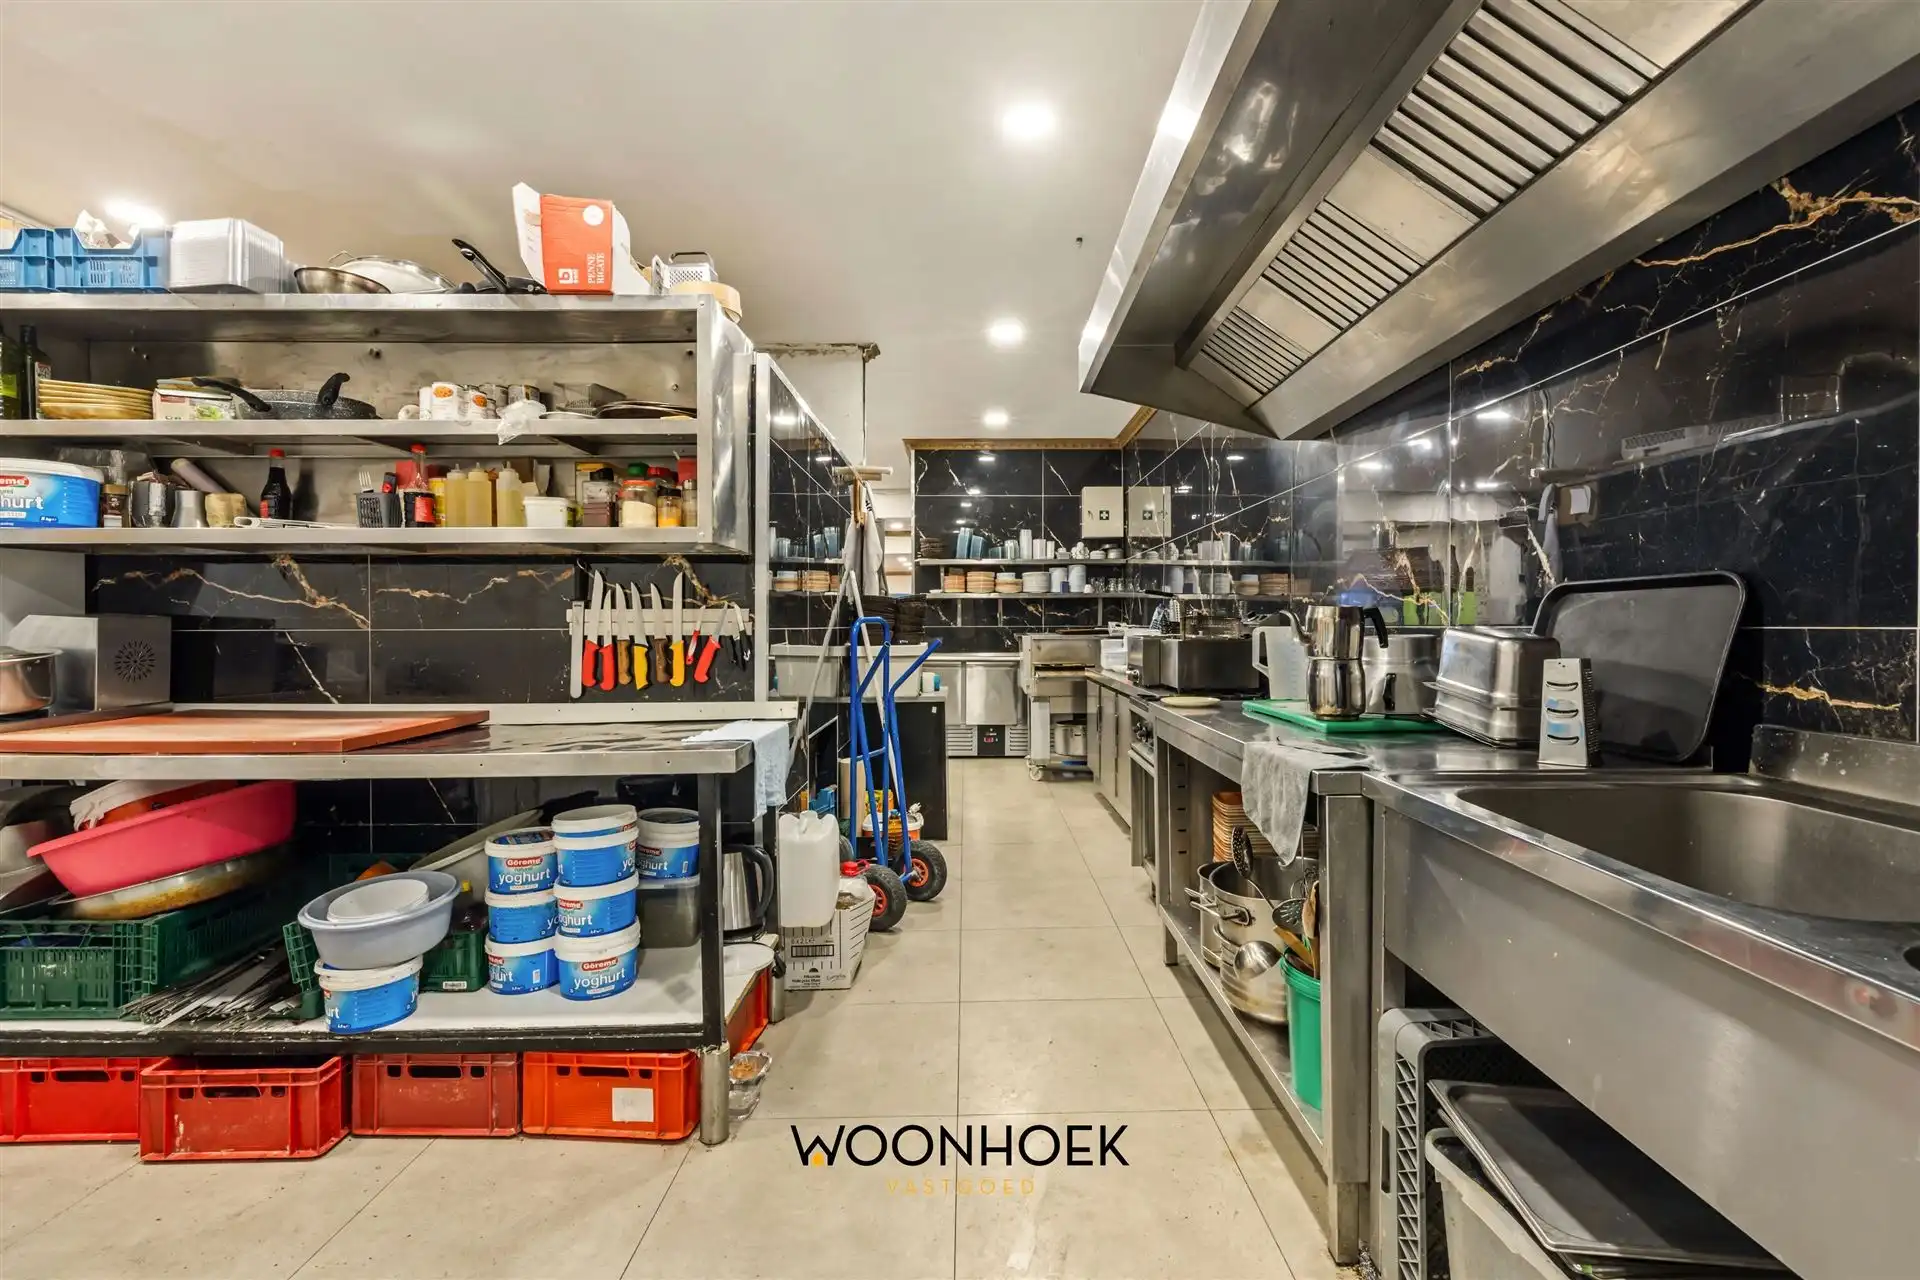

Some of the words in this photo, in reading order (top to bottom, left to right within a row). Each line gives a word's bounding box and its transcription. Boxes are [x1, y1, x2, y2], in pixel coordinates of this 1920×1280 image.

[587, 253, 596, 284] PENNE
[596, 252, 605, 284] RIGATE
[0, 495, 44, 510] hurt
[498, 868, 551, 886] yoghurt
[573, 967, 626, 990] yoghurt
